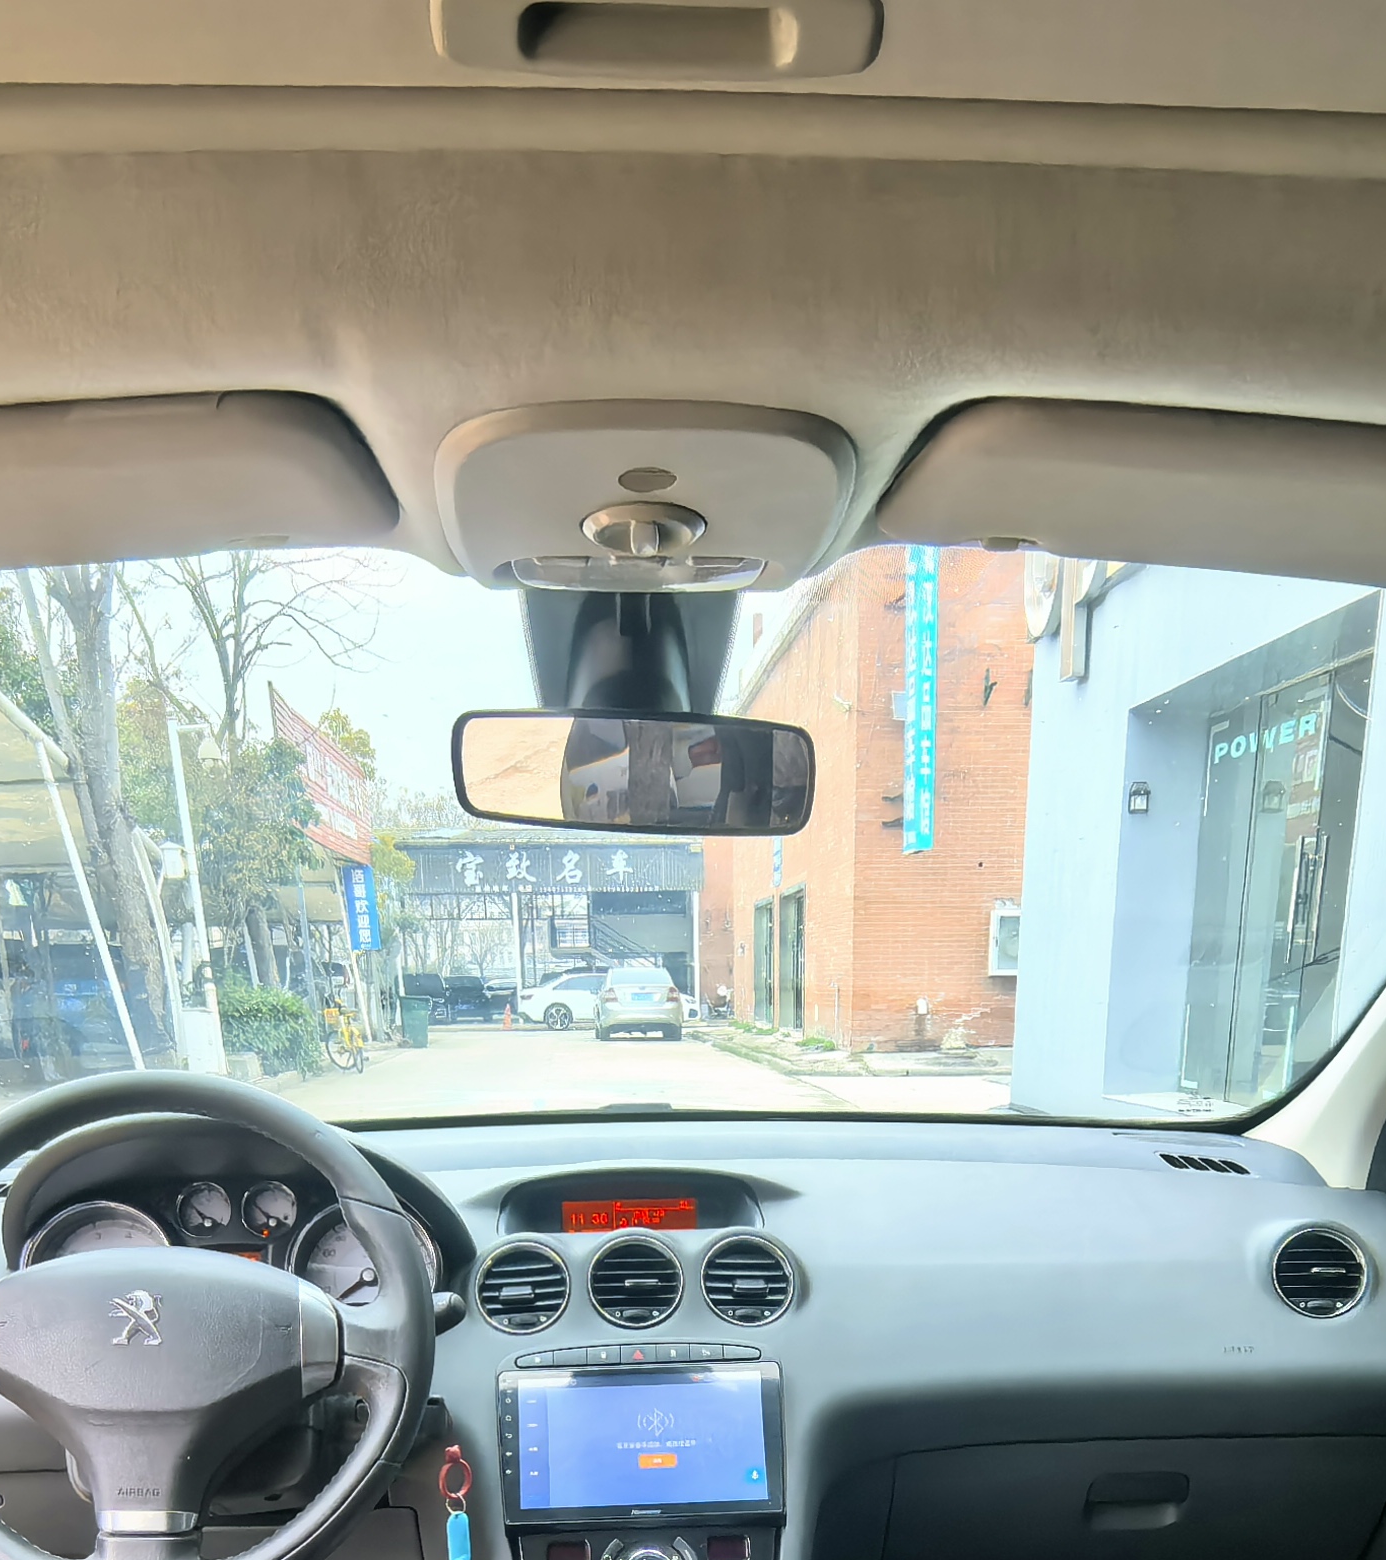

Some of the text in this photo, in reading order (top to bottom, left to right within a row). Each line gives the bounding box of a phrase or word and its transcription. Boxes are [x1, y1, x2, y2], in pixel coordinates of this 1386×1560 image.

[1213, 712, 1318, 765] POWER
[456, 849, 634, 887] 宝致名车
[117, 1487, 161, 1497] AIRBAG
